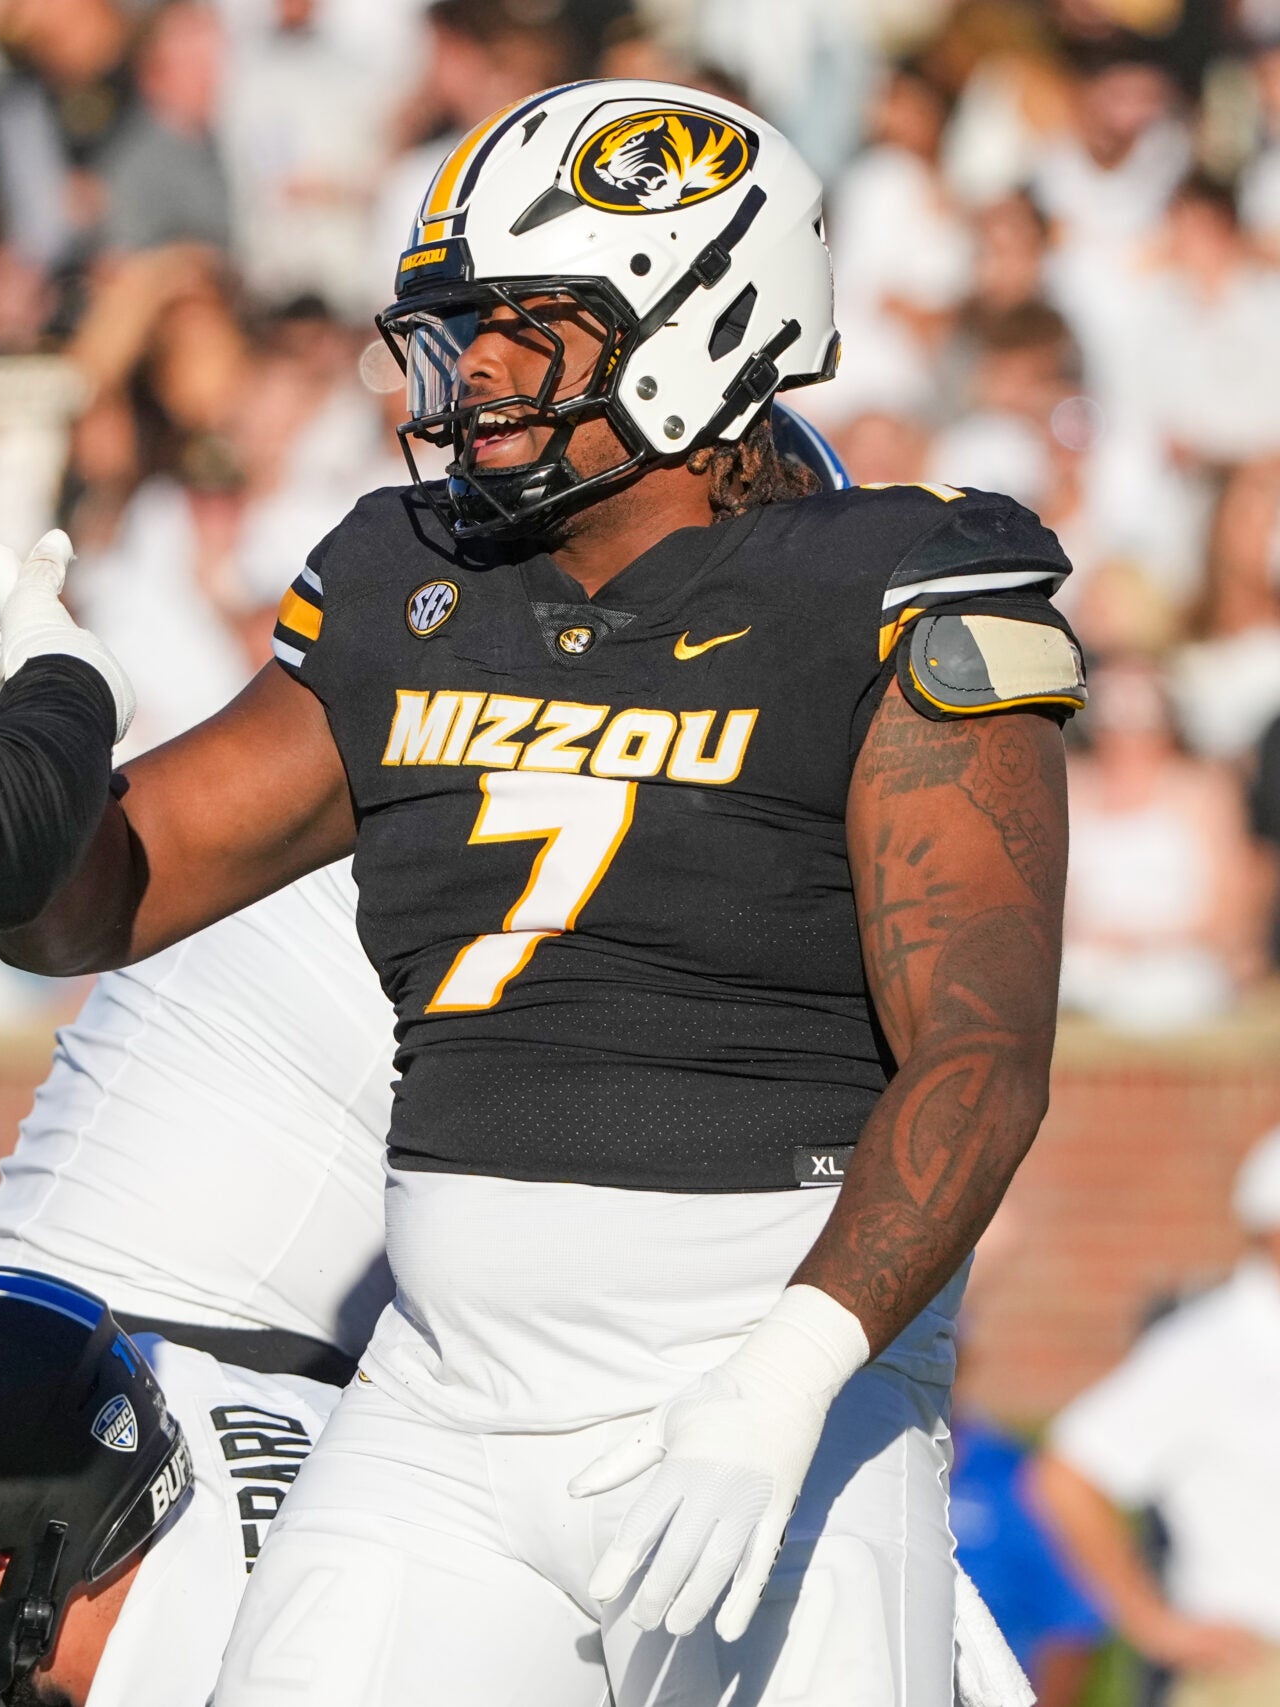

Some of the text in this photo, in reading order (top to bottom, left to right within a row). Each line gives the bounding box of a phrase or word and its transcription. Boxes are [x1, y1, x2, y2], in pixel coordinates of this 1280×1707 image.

[409, 583, 454, 630] SEC
[381, 689, 760, 785] MIZZOU
[424, 769, 639, 1015] 7
[811, 1156, 844, 1176] XL
[102, 1406, 133, 1444] MAC
